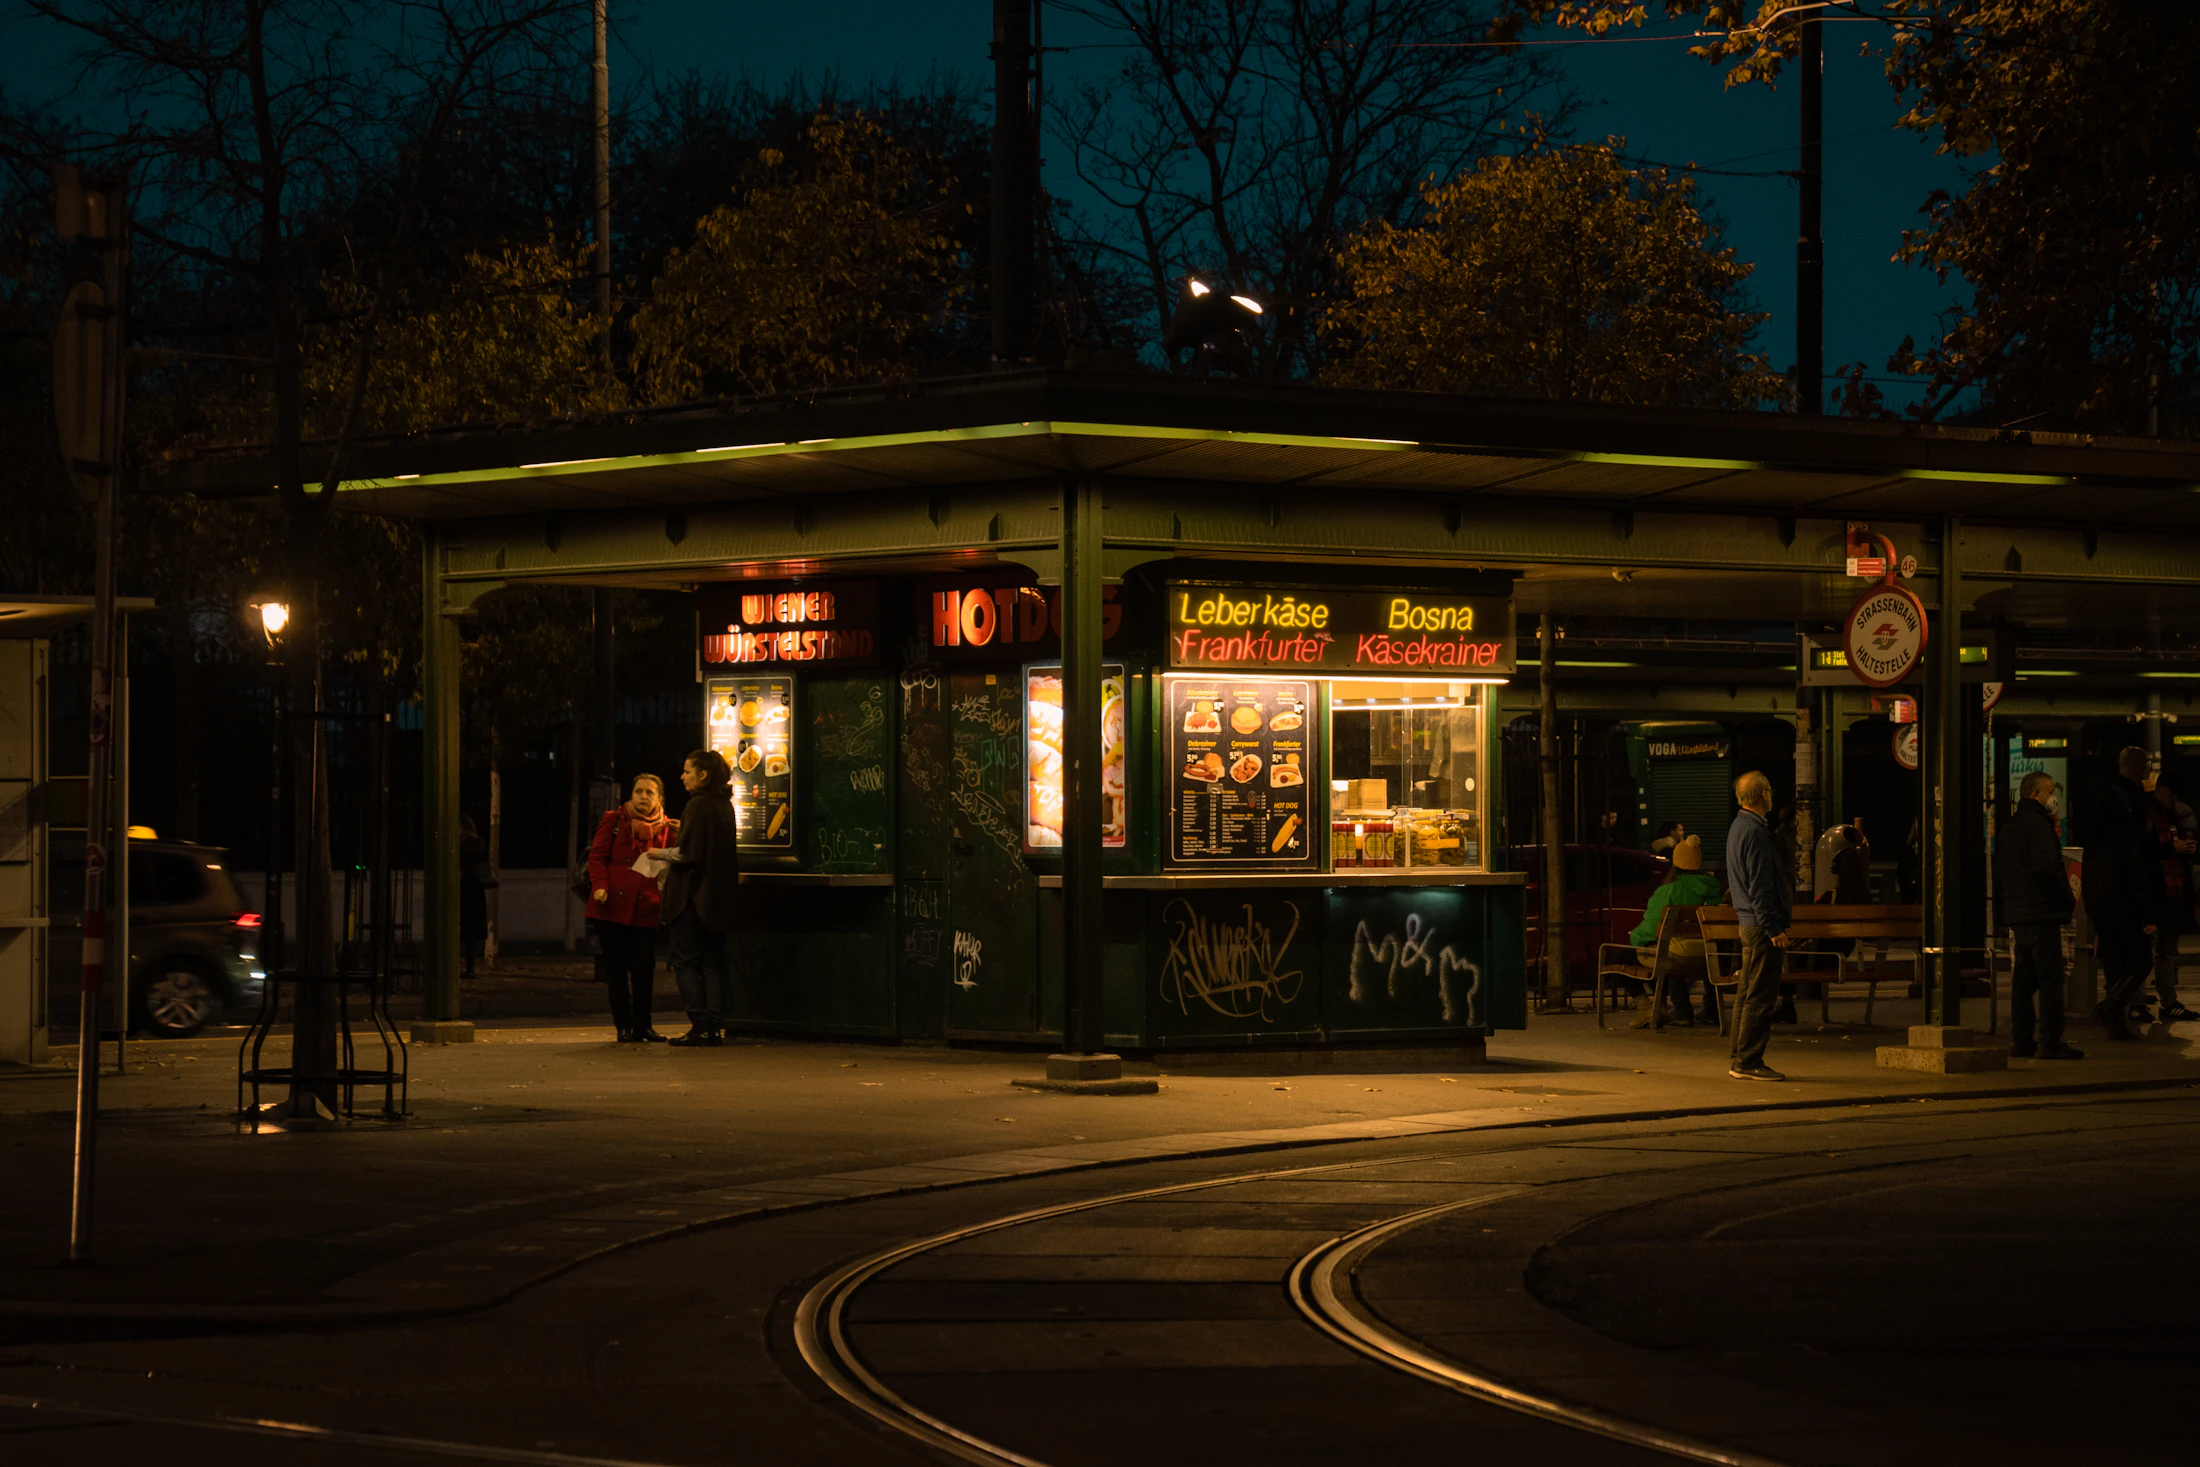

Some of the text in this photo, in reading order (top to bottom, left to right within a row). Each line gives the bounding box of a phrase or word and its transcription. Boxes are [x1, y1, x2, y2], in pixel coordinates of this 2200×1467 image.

[1901, 560, 1915, 573] 46
[741, 591, 836, 625] WIENER
[1180, 592, 1474, 631] Leberkäse Bosna
[1856, 597, 1918, 633] STRASSENBAHN
[703, 624, 875, 664] WÜRSTELSTAND
[1180, 628, 1503, 667] Frankfurter Käsekrainer
[1856, 645, 1911, 675] HALTESTELLE
[1231, 740, 1260, 749] Currywurst
[1272, 740, 1302, 749] Frankfurter
[1648, 742, 1677, 756] VOGA
[1273, 801, 1299, 810] HOT DOG
